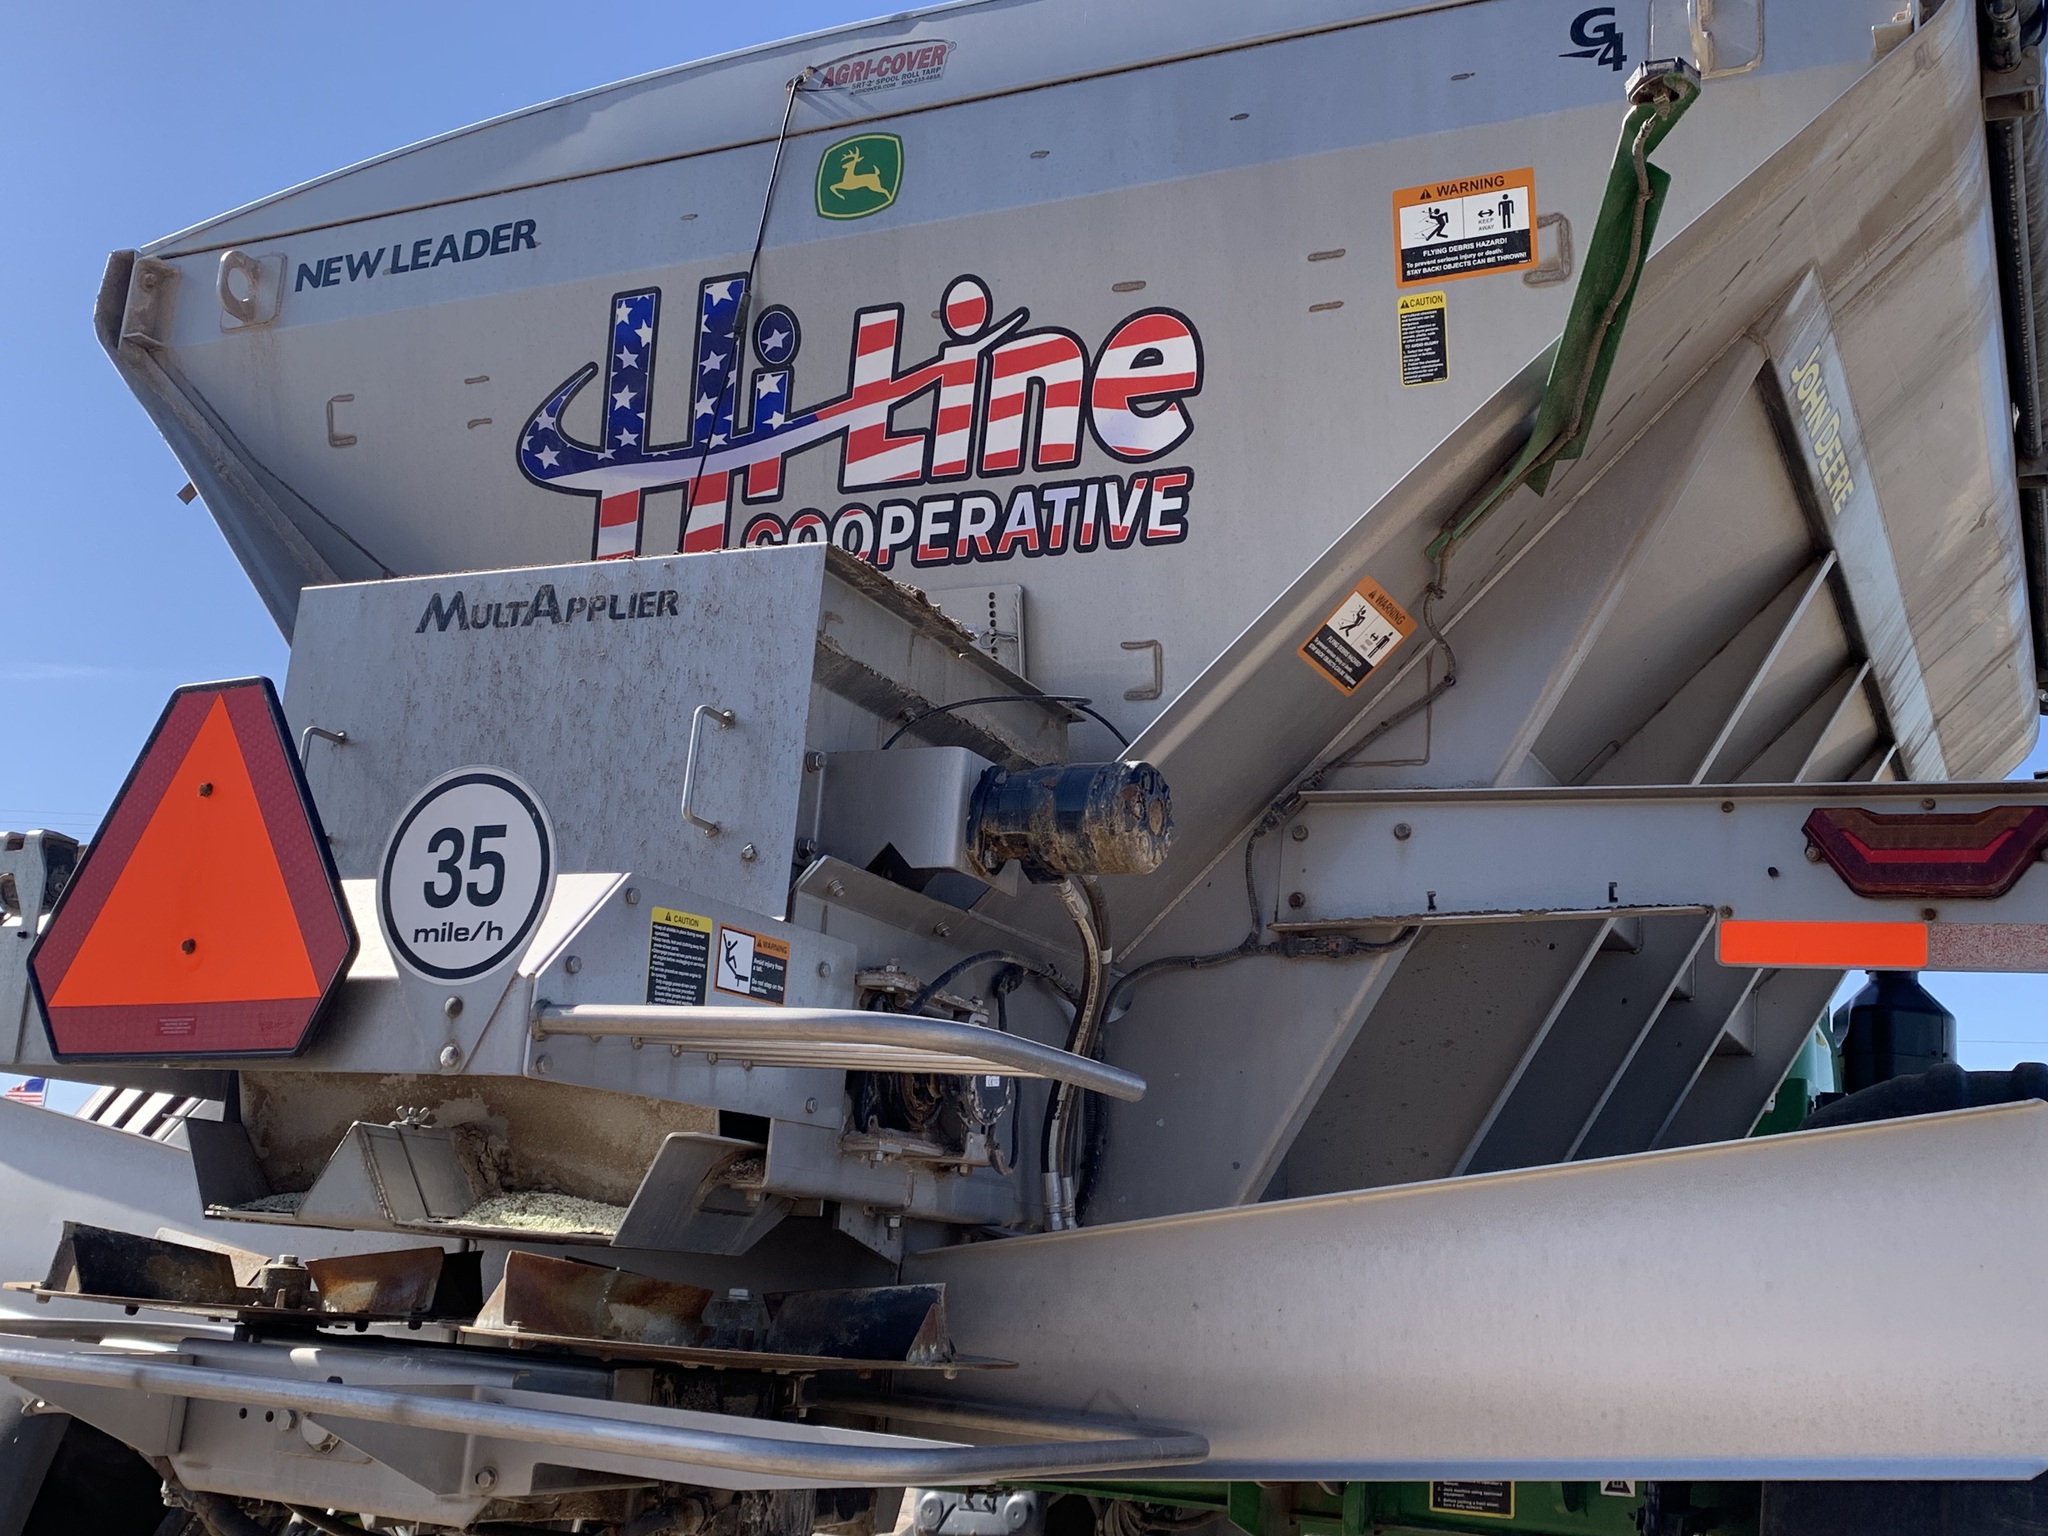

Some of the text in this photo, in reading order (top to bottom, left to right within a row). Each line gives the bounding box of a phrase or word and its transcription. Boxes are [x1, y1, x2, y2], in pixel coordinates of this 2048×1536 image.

[1569, 7, 1627, 71] G4
[820, 44, 946, 88] AGRI-COVER
[875, 75, 899, 85] SPOOL
[901, 70, 920, 80] ROLL
[922, 66, 941, 75] TARP
[1437, 175, 1505, 197] WARNING
[295, 219, 537, 292] NEW LEADER
[1423, 237, 1508, 257] FLYING DEBRIS HAZARD!
[1406, 252, 1527, 276] STAY BACK! OBJECTS CAN BE THROWN!
[1414, 258, 1437, 269] prevent
[1437, 255, 1459, 264] serious
[1459, 252, 1476, 262] injury
[1410, 295, 1443, 308] CAUTION
[1791, 344, 1854, 516] JOHN DEERE
[1375, 592, 1406, 626] WARNING
[423, 823, 508, 909] 35
[413, 920, 504, 943] mile/h
[673, 914, 699, 927] CAUTION
[762, 940, 788, 955] WARNING
